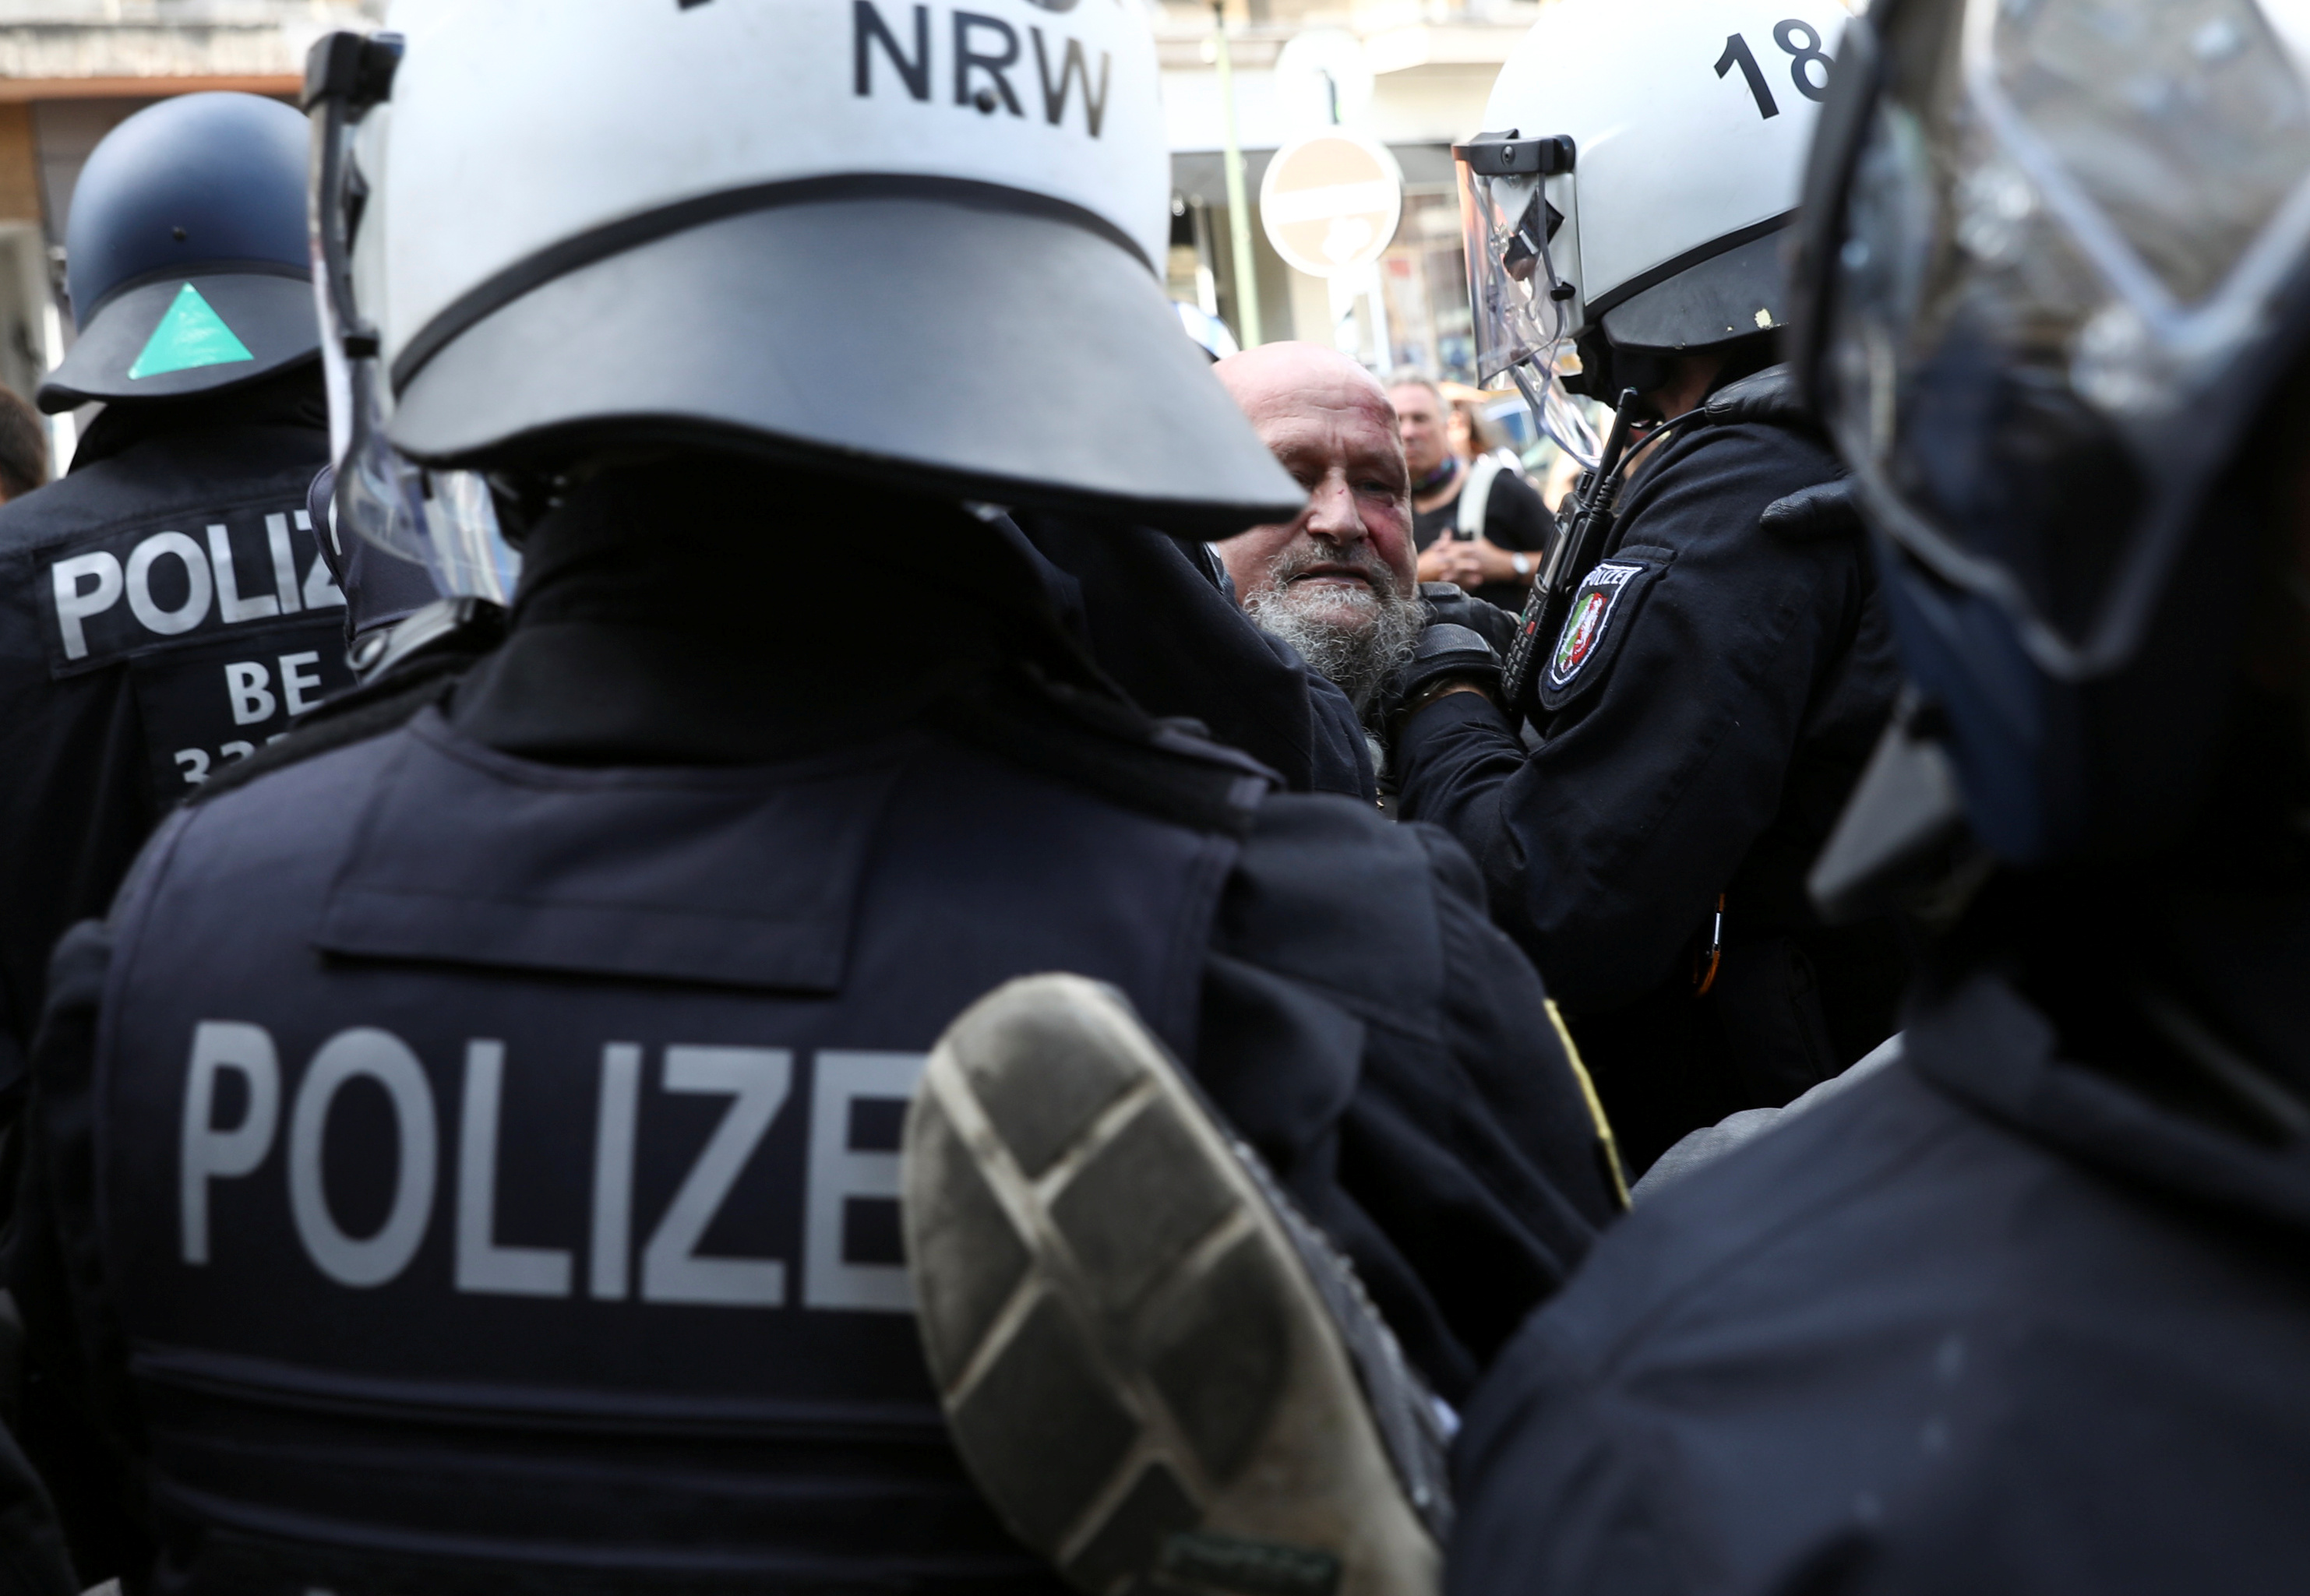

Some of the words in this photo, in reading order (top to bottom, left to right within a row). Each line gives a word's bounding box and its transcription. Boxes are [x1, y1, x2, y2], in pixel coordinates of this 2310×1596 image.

[852, 0, 1110, 139] NRW
[1714, 19, 1835, 120] 18
[51, 511, 347, 661] POLIZ
[224, 650, 323, 725] BE
[180, 1020, 933, 1314] POLIZE
